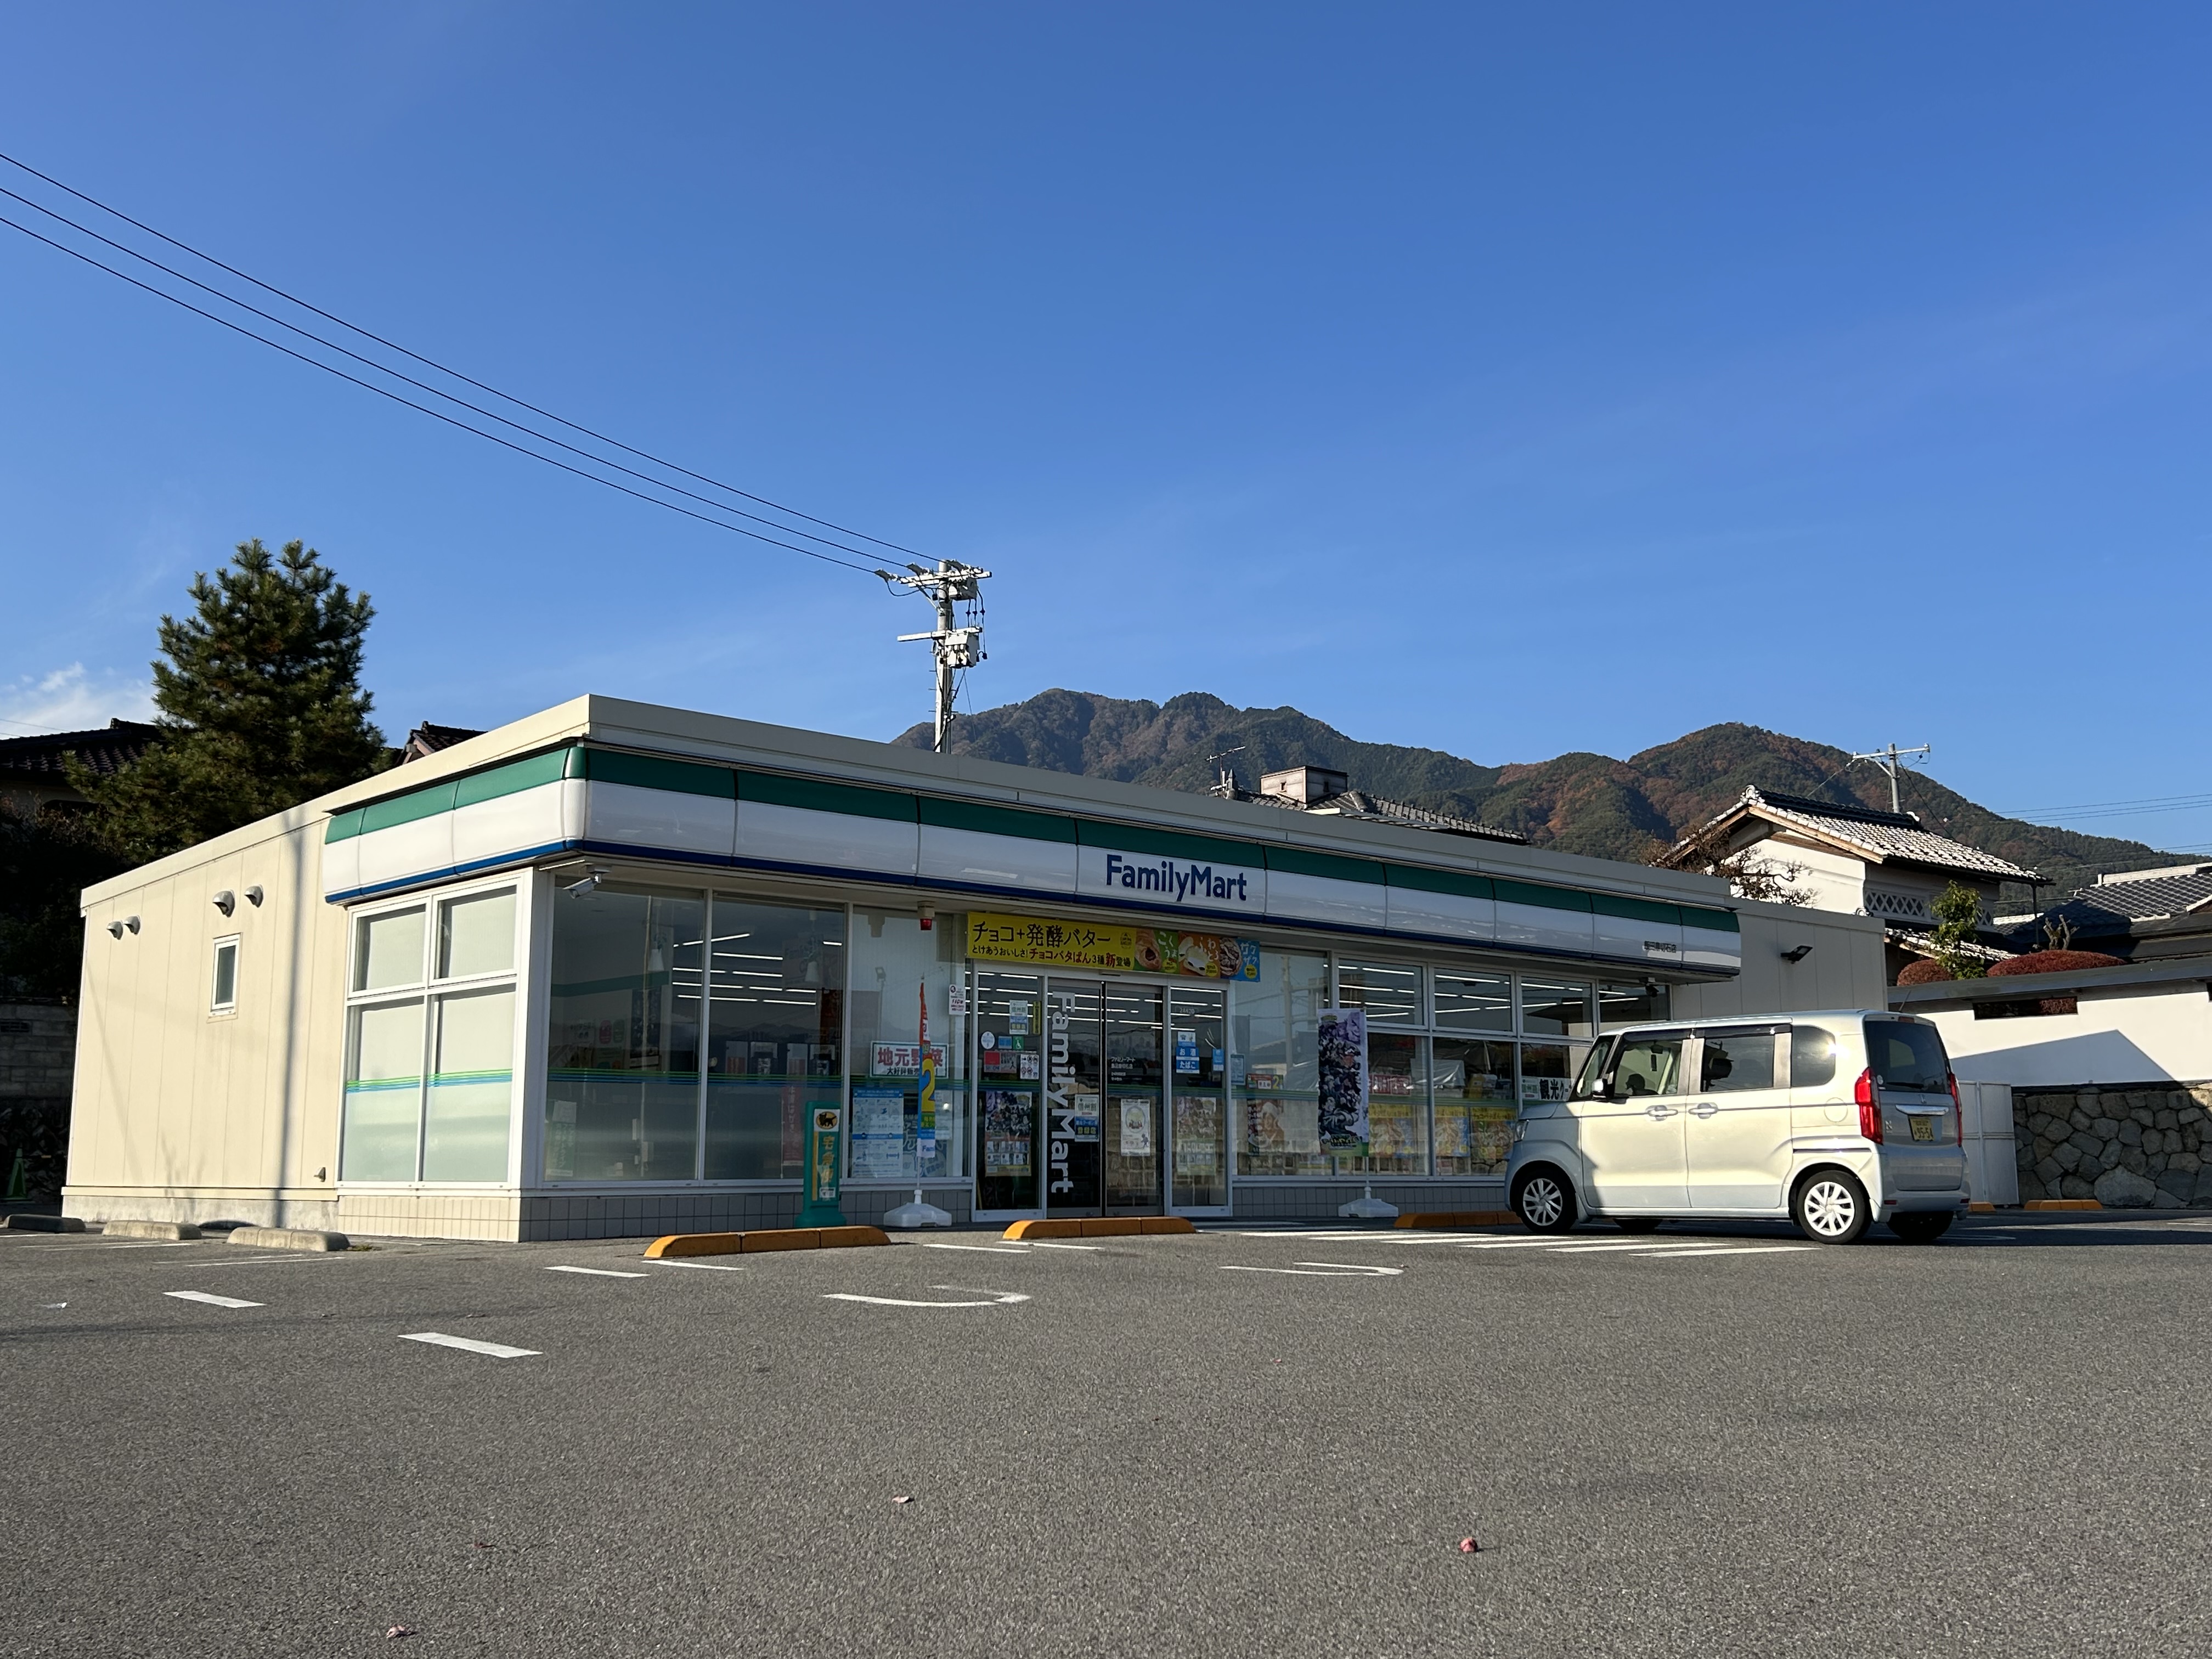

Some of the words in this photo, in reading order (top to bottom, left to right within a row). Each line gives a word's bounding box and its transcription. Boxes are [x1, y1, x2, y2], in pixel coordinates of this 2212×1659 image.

[1106, 854, 1247, 902] FamilyMart
[972, 921, 1111, 949] チョコ+発酵バター
[1158, 931, 1174, 947] こく
[1180, 1061, 1196, 1069] たばこ
[1046, 991, 1076, 1194] FamilyMart
